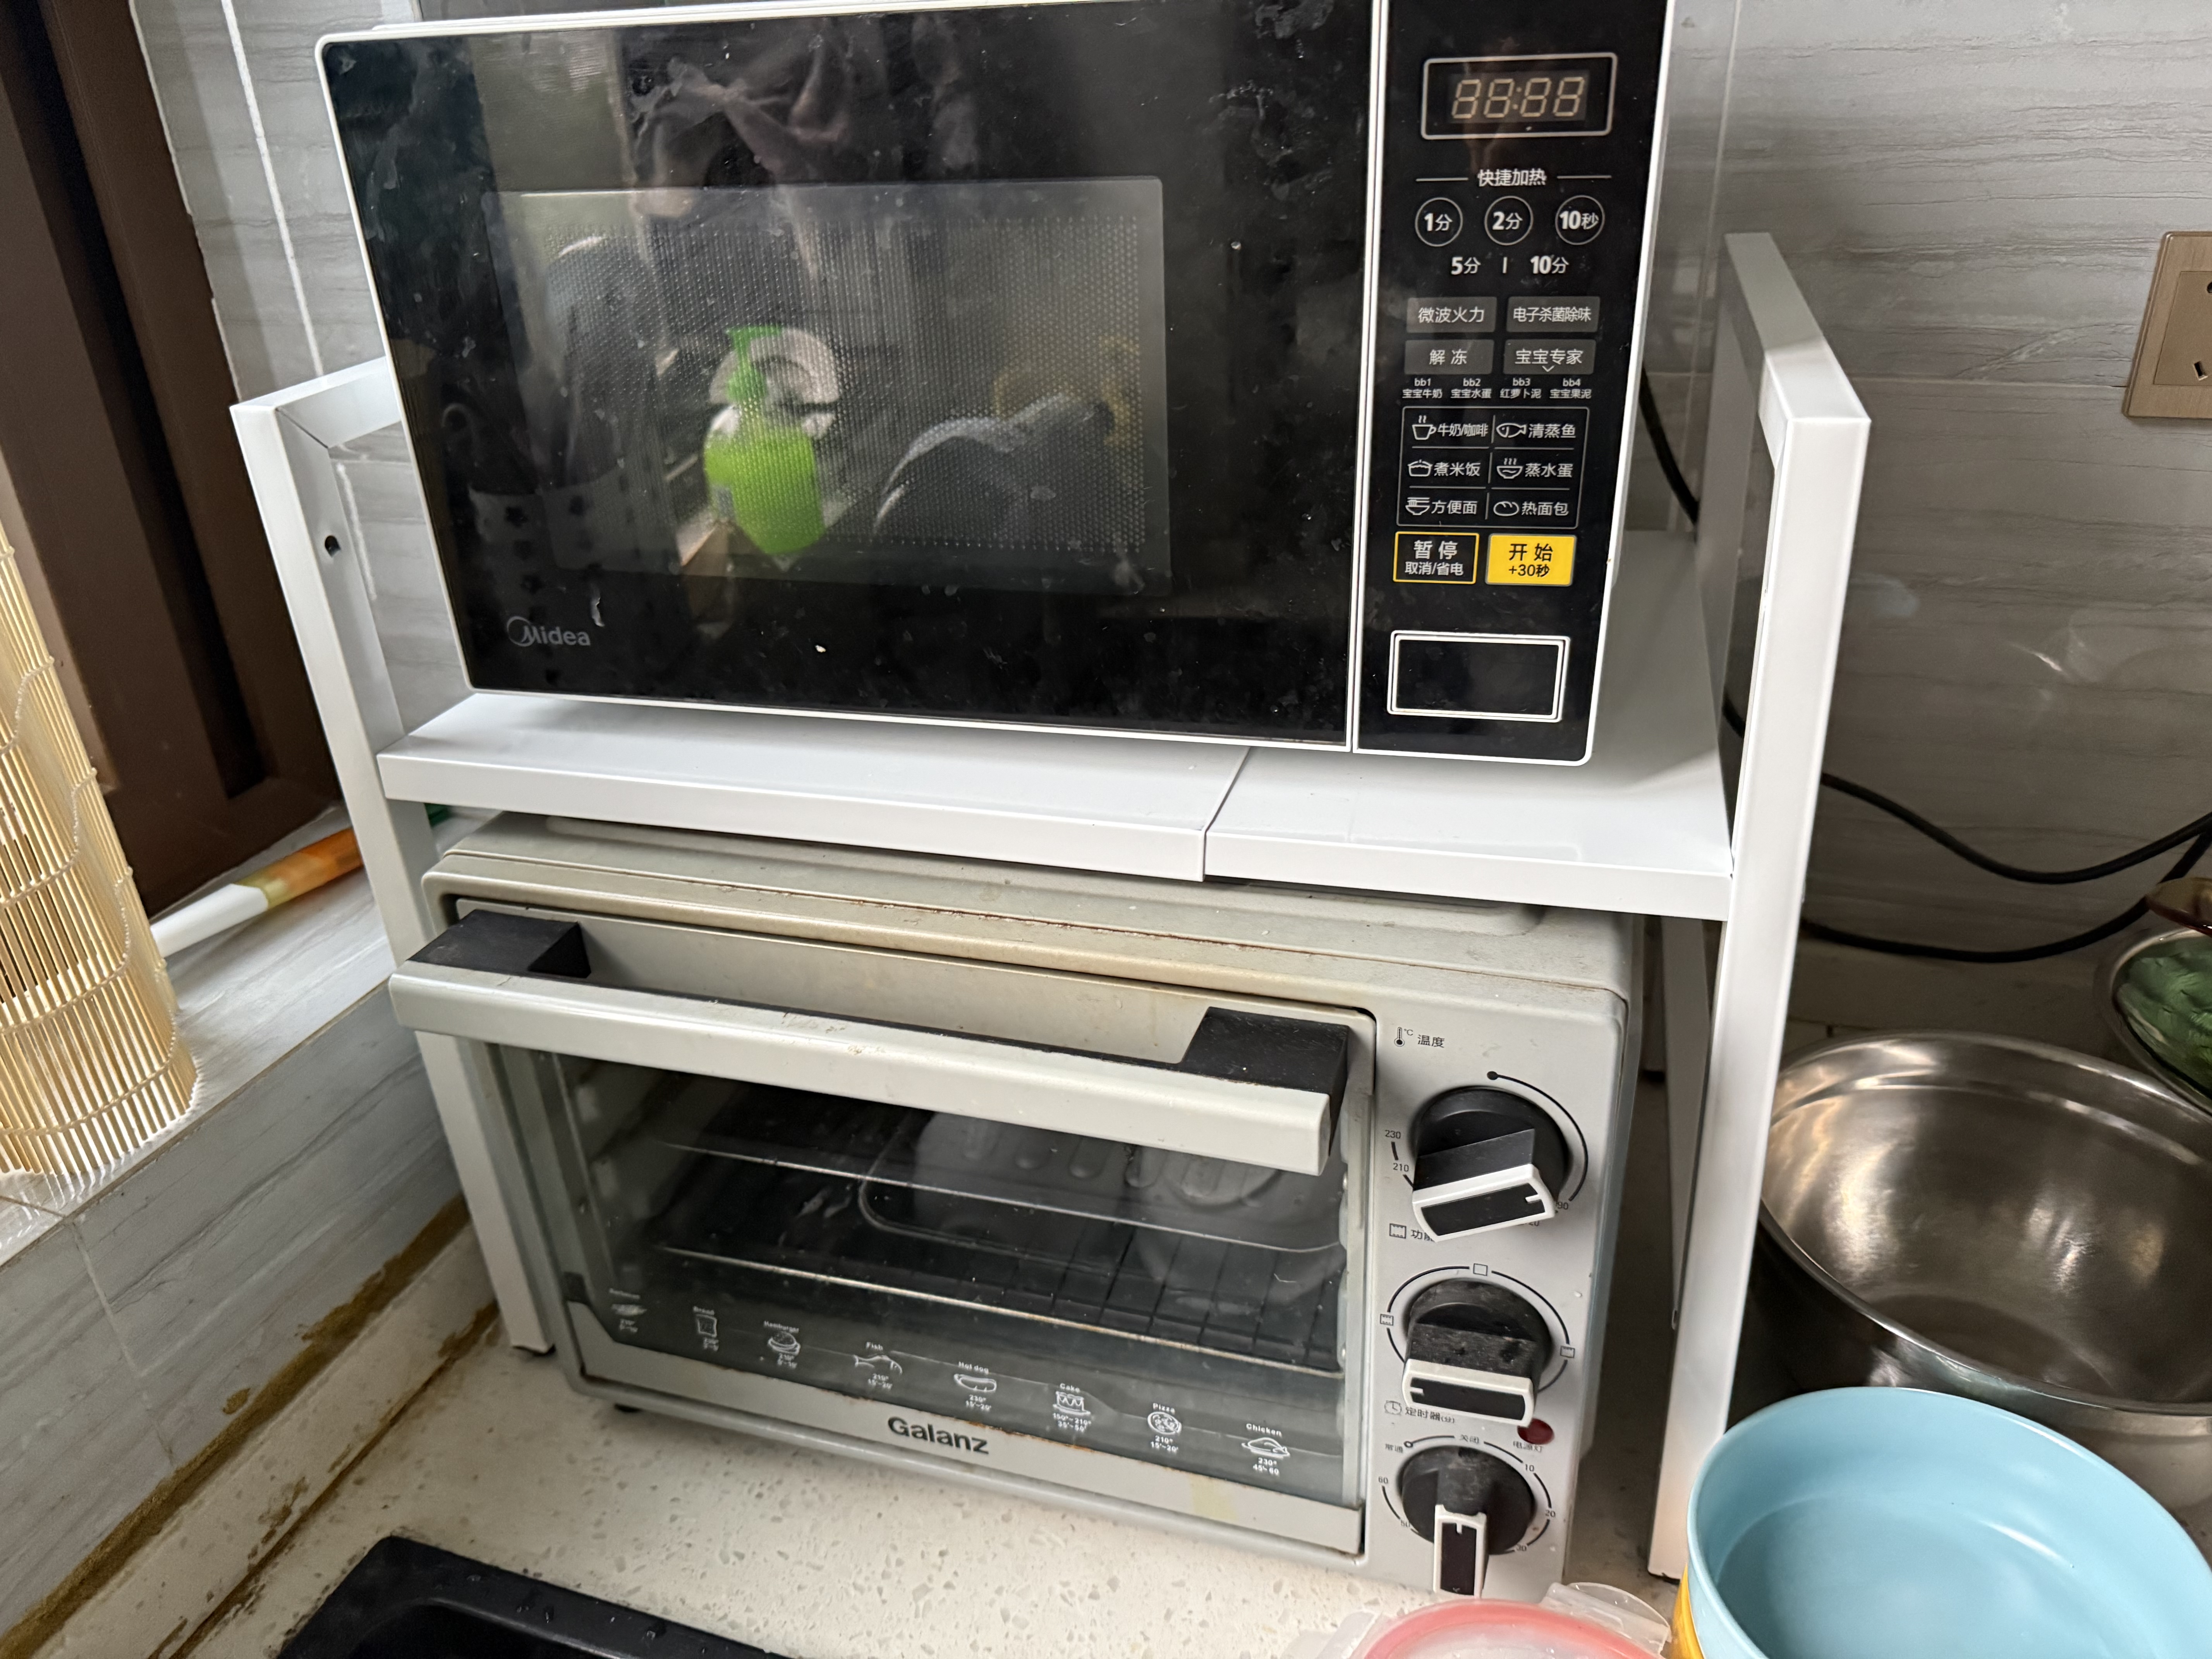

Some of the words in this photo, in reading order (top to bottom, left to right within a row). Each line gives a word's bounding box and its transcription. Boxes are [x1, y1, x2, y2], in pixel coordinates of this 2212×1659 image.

[1452, 77, 1585, 118] 88:88
[1477, 168, 1547, 187] 快捷加热
[1424, 213, 1452, 232] 1分
[1492, 211, 1523, 230] 2分
[1559, 211, 1599, 230] 10秒
[1451, 257, 1481, 275] 5分
[1530, 256, 1569, 274] 10分
[1418, 307, 1484, 323] 微波火力
[1513, 307, 1591, 323] 电子杀菌除味
[1429, 349, 1467, 366] 解冻
[1515, 348, 1583, 365] 宝宝专家
[1414, 378, 1431, 386] bb1
[1463, 378, 1480, 387] bb2
[1513, 378, 1530, 386] bb3
[1563, 378, 1581, 387] bb4
[1402, 389, 1443, 399] 宝宝牛奶
[1450, 389, 1492, 399] 宝宝水蛋
[1499, 389, 1541, 399] 红萝卜泥
[1549, 389, 1592, 400] 宝宝果泥
[1437, 423, 1489, 437] 牛奶/咖啡
[1528, 423, 1576, 438] 清蒸鱼
[1434, 462, 1481, 477] 煮米饭
[1525, 463, 1573, 478] 蒸水蛋
[1431, 500, 1477, 515] 方便面
[1521, 502, 1569, 516] 热面包
[1413, 540, 1458, 560] 暂停
[1509, 543, 1553, 562] 开始
[1405, 562, 1464, 576] 取消/省电
[1508, 564, 1550, 577] +30秒
[507, 616, 591, 647] Midea
[1417, 1034, 1445, 1048] 温度
[1385, 1130, 1401, 1139] 230
[1393, 1163, 1409, 1172] 210
[1060, 1383, 1080, 1393] Cake
[1153, 1403, 1176, 1415] Pizza
[888, 1416, 989, 1455] Galanz
[1246, 1424, 1283, 1437] Chicken
